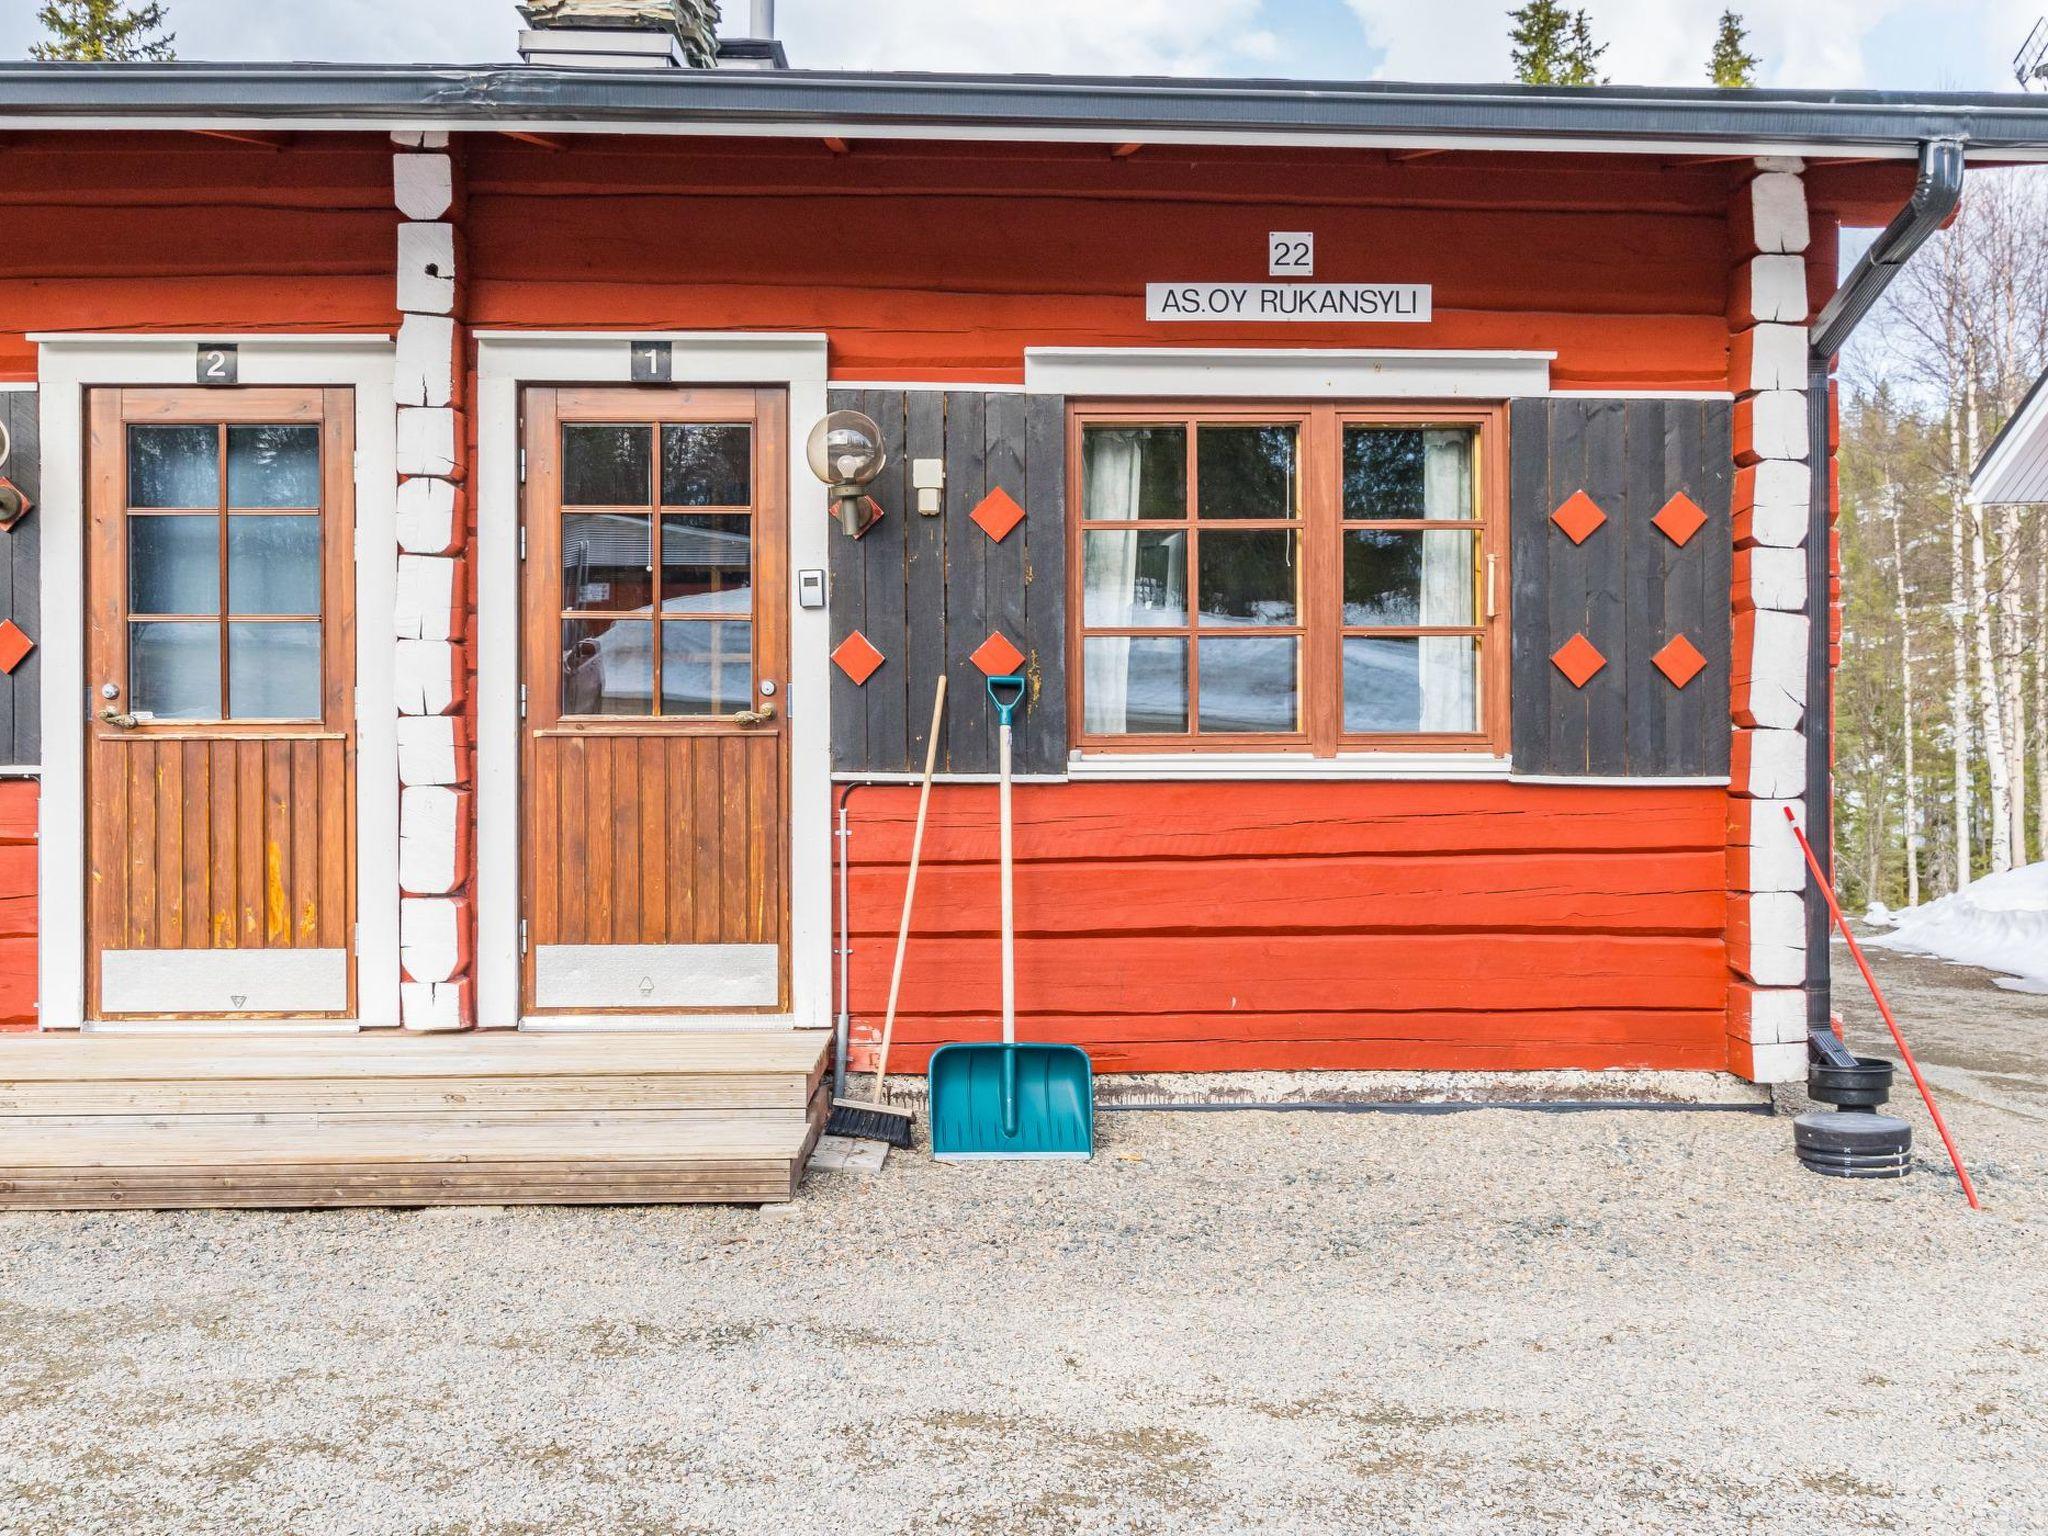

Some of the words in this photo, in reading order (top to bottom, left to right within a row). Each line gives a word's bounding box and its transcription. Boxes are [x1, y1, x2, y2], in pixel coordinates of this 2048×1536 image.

[1273, 242, 1310, 266] 22
[1161, 288, 1248, 314] AS.OY
[1260, 289, 1417, 314] RUKANSYLI
[206, 350, 226, 377] 2
[644, 349, 658, 374] 1
